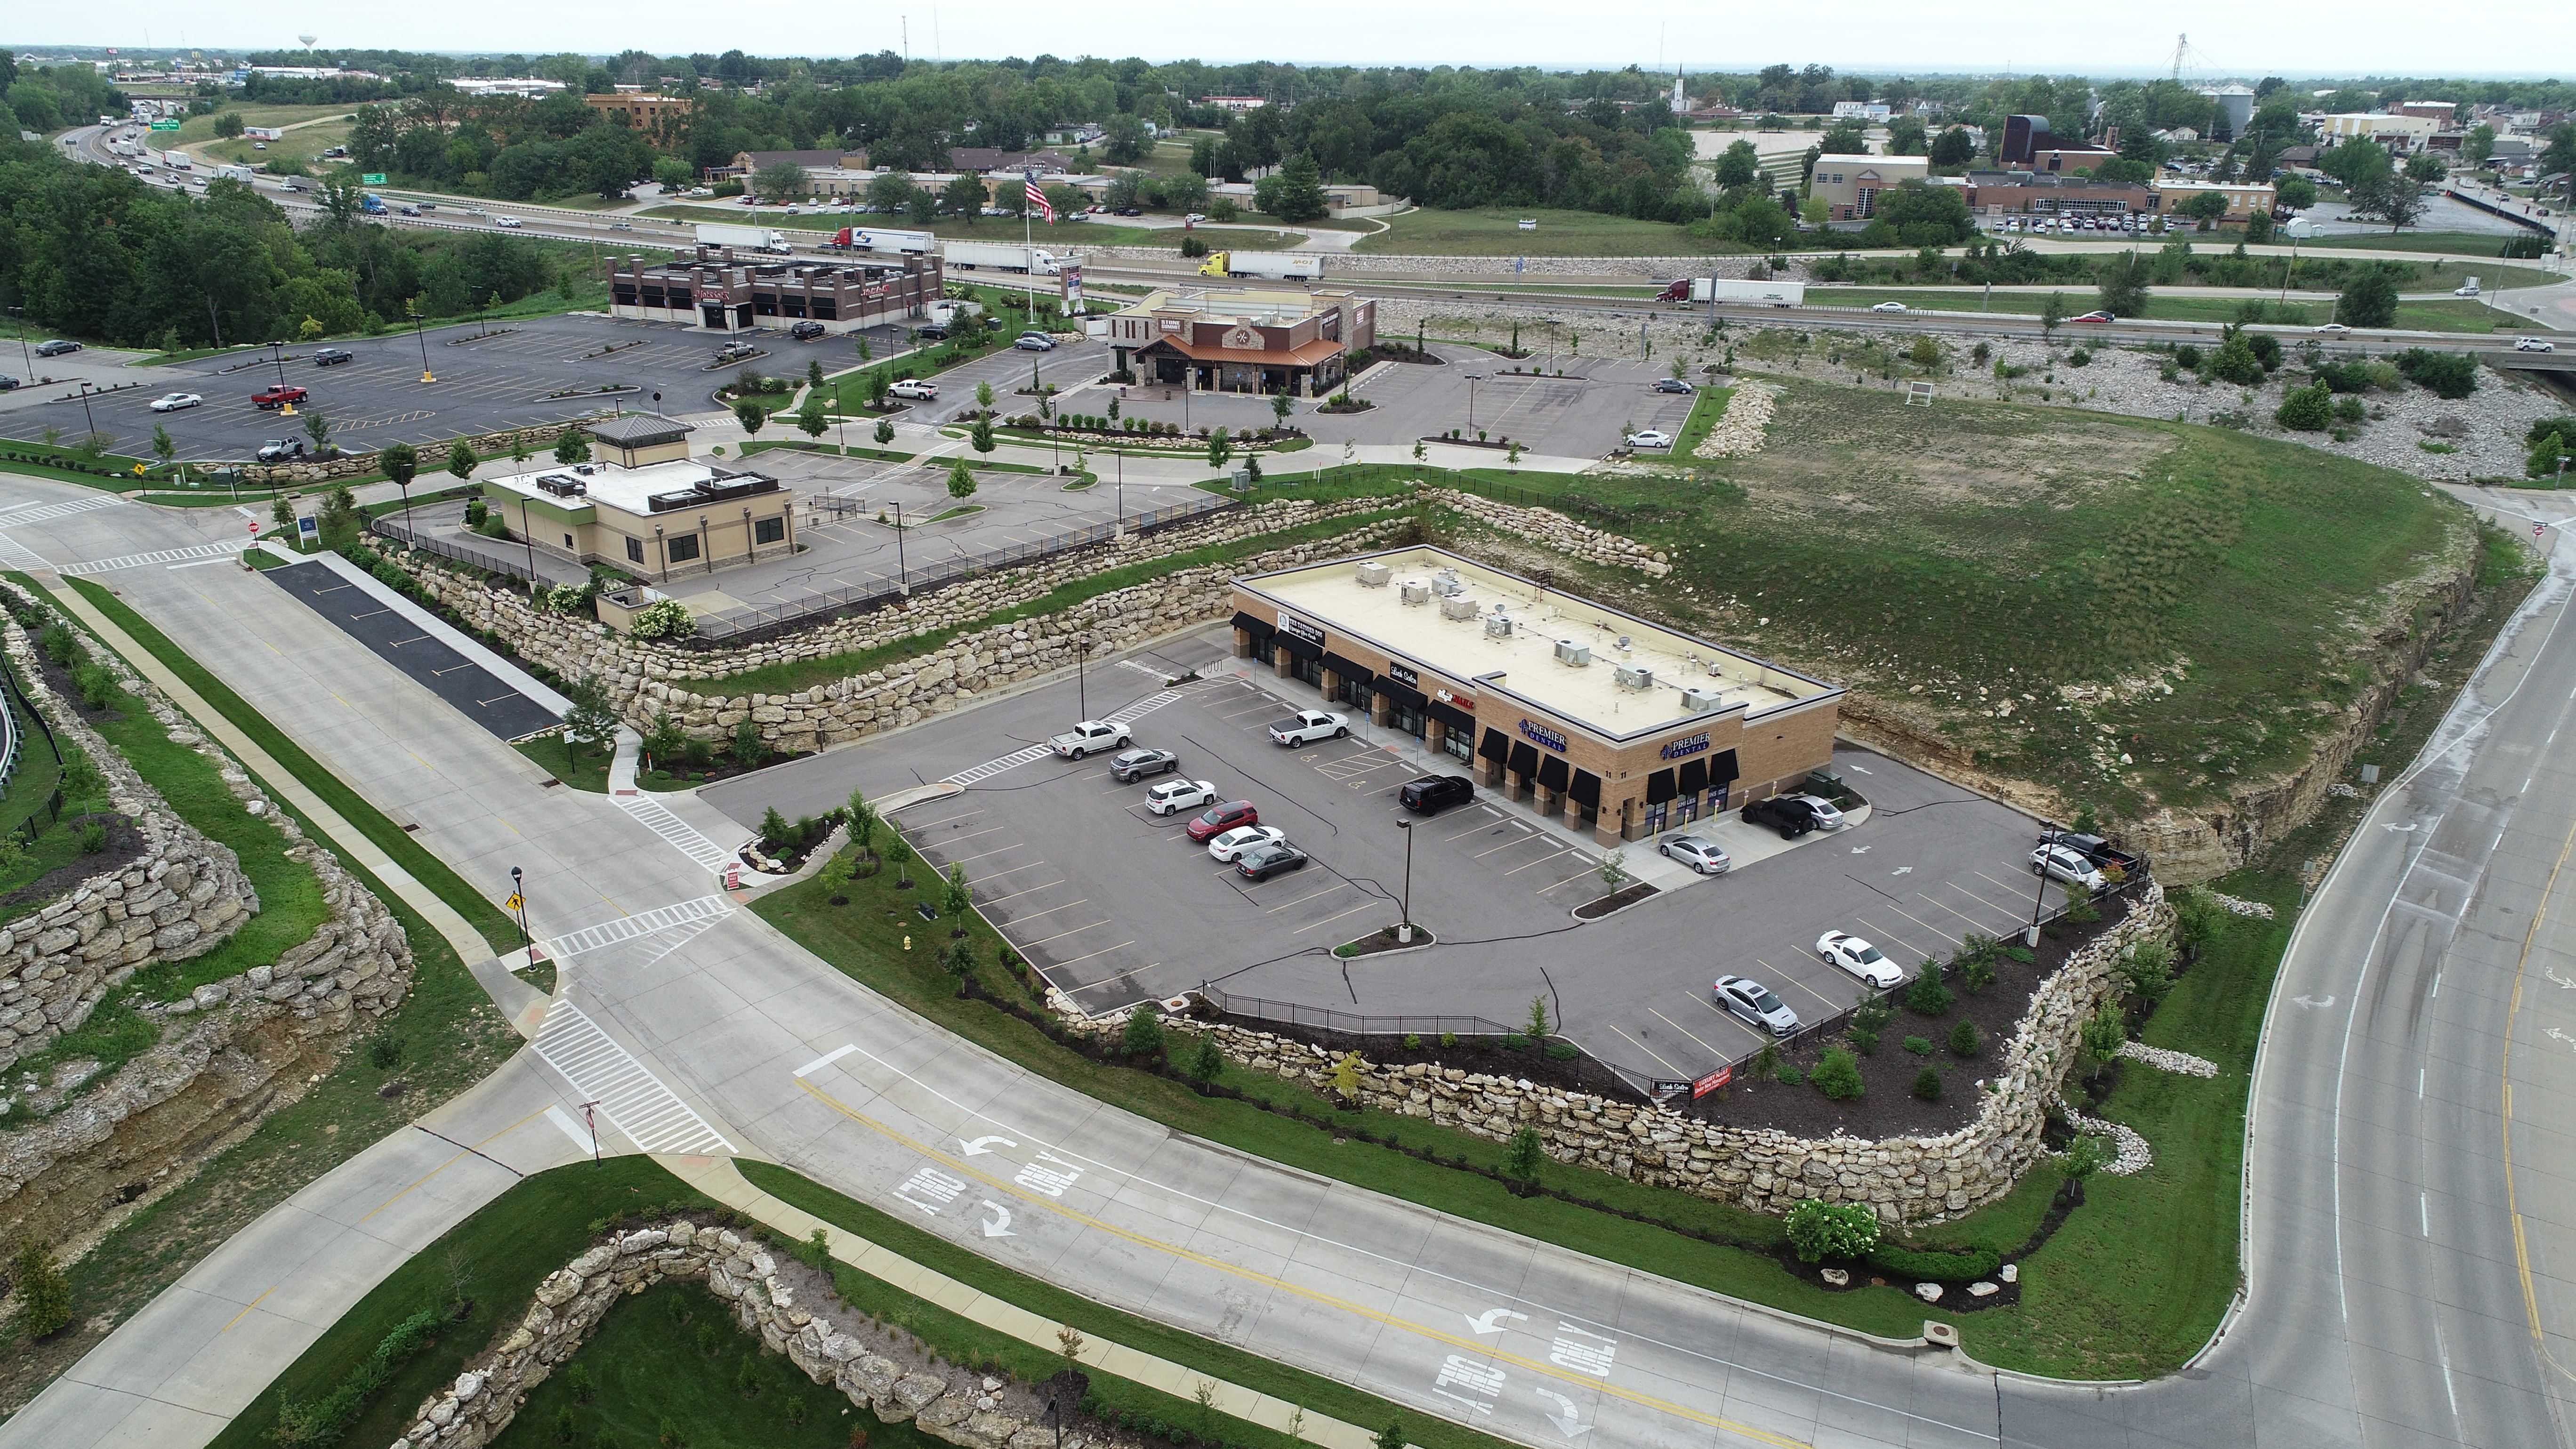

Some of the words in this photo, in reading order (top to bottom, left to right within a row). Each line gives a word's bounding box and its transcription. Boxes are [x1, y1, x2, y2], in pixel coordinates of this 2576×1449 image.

[1315, 629, 1323, 638] DOG
[1391, 666, 1403, 678] Lush
[1403, 671, 1417, 684] Salon
[1453, 695, 1474, 709] NAILS
[1528, 721, 1566, 745] PREMIER
[1530, 732, 1562, 751] DENTAL
[1672, 732, 1710, 751] PREMIER
[1674, 743, 1707, 757] DENTAL
[1605, 770, 1611, 779] 11
[1620, 771, 1627, 779] 11
[1677, 797, 1696, 808] SMILES
[1699, 1074, 1717, 1087] LUXURY
[1014, 1151, 1085, 1197] ONLY
[893, 1167, 966, 1216] ONLY
[1549, 1320, 1618, 1377] ONLY
[1432, 1354, 1506, 1415] ONLY
